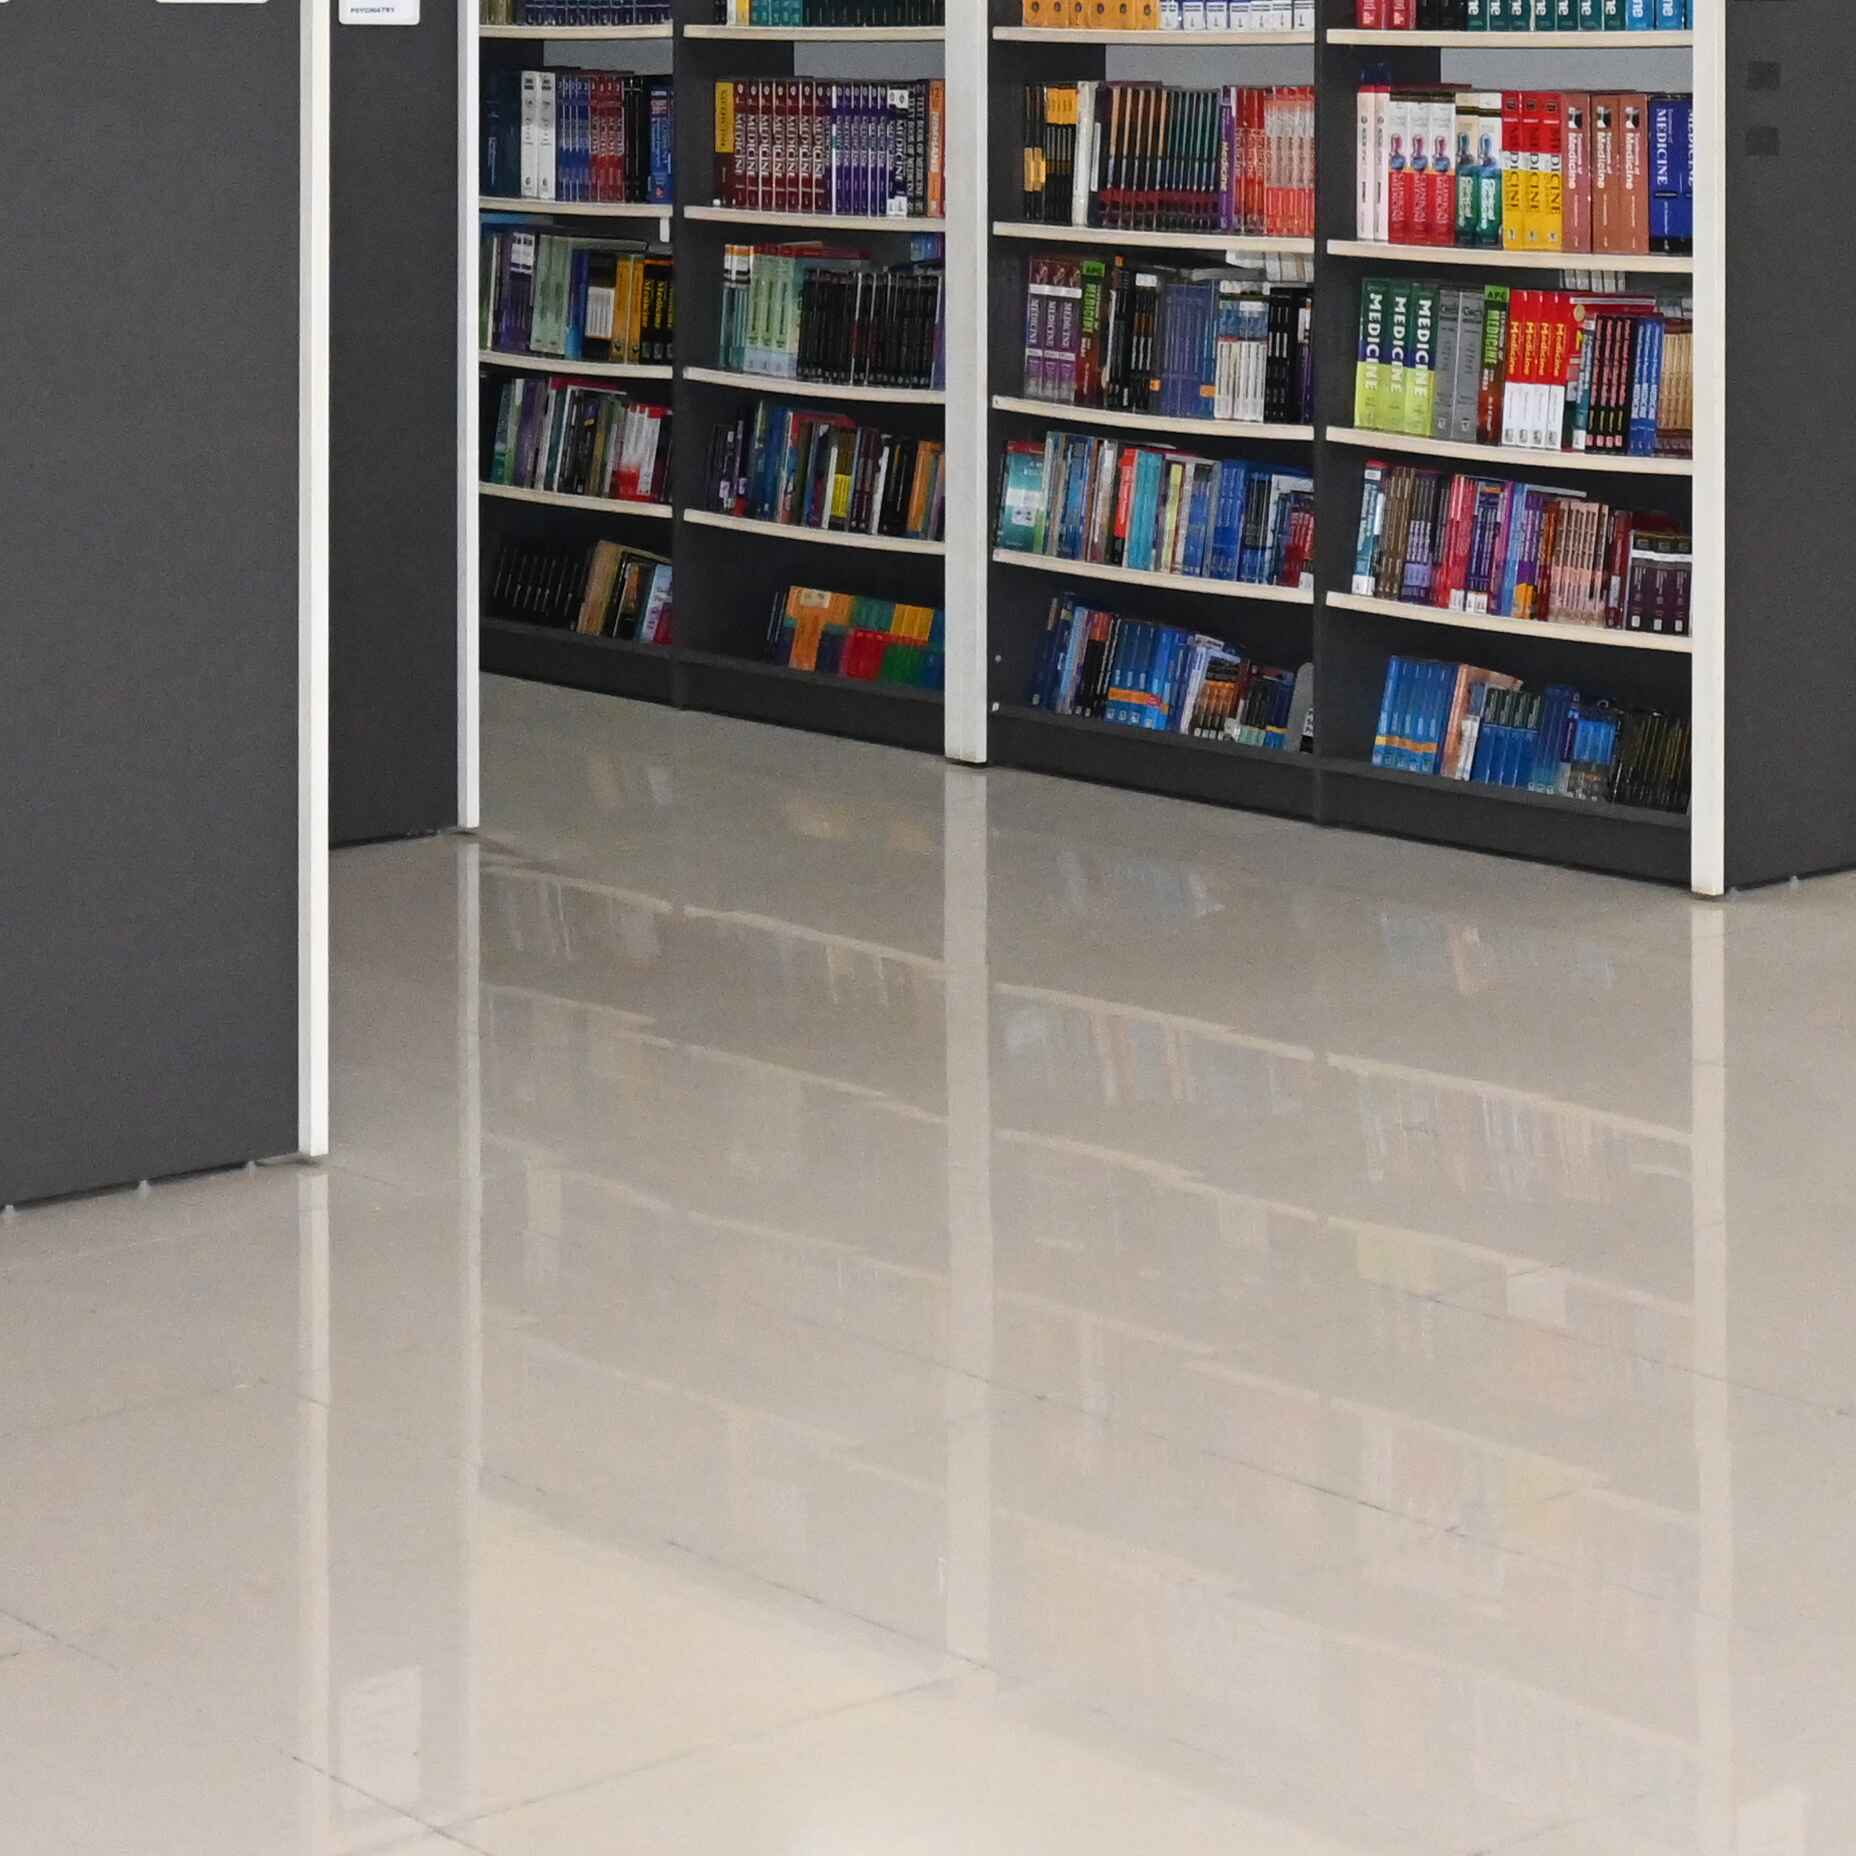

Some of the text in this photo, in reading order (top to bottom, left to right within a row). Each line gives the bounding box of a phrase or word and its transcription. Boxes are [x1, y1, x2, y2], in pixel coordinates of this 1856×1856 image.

[1568, 133, 1577, 189] Medicine
[1597, 132, 1606, 188] Medicine
[1625, 133, 1634, 190] Medicine
[1656, 109, 1668, 185] MEDICINE
[1366, 293, 1383, 391] MEDICINE
[1391, 297, 1407, 393] MEDICINE
[1414, 300, 1432, 399] MEDICINE
[1485, 310, 1499, 364] MEDICINE
[1508, 321, 1519, 374] Medicine
[1523, 322, 1534, 375] Medicine
[1538, 322, 1549, 376] Medicine
[1553, 323, 1565, 377] Medicine
